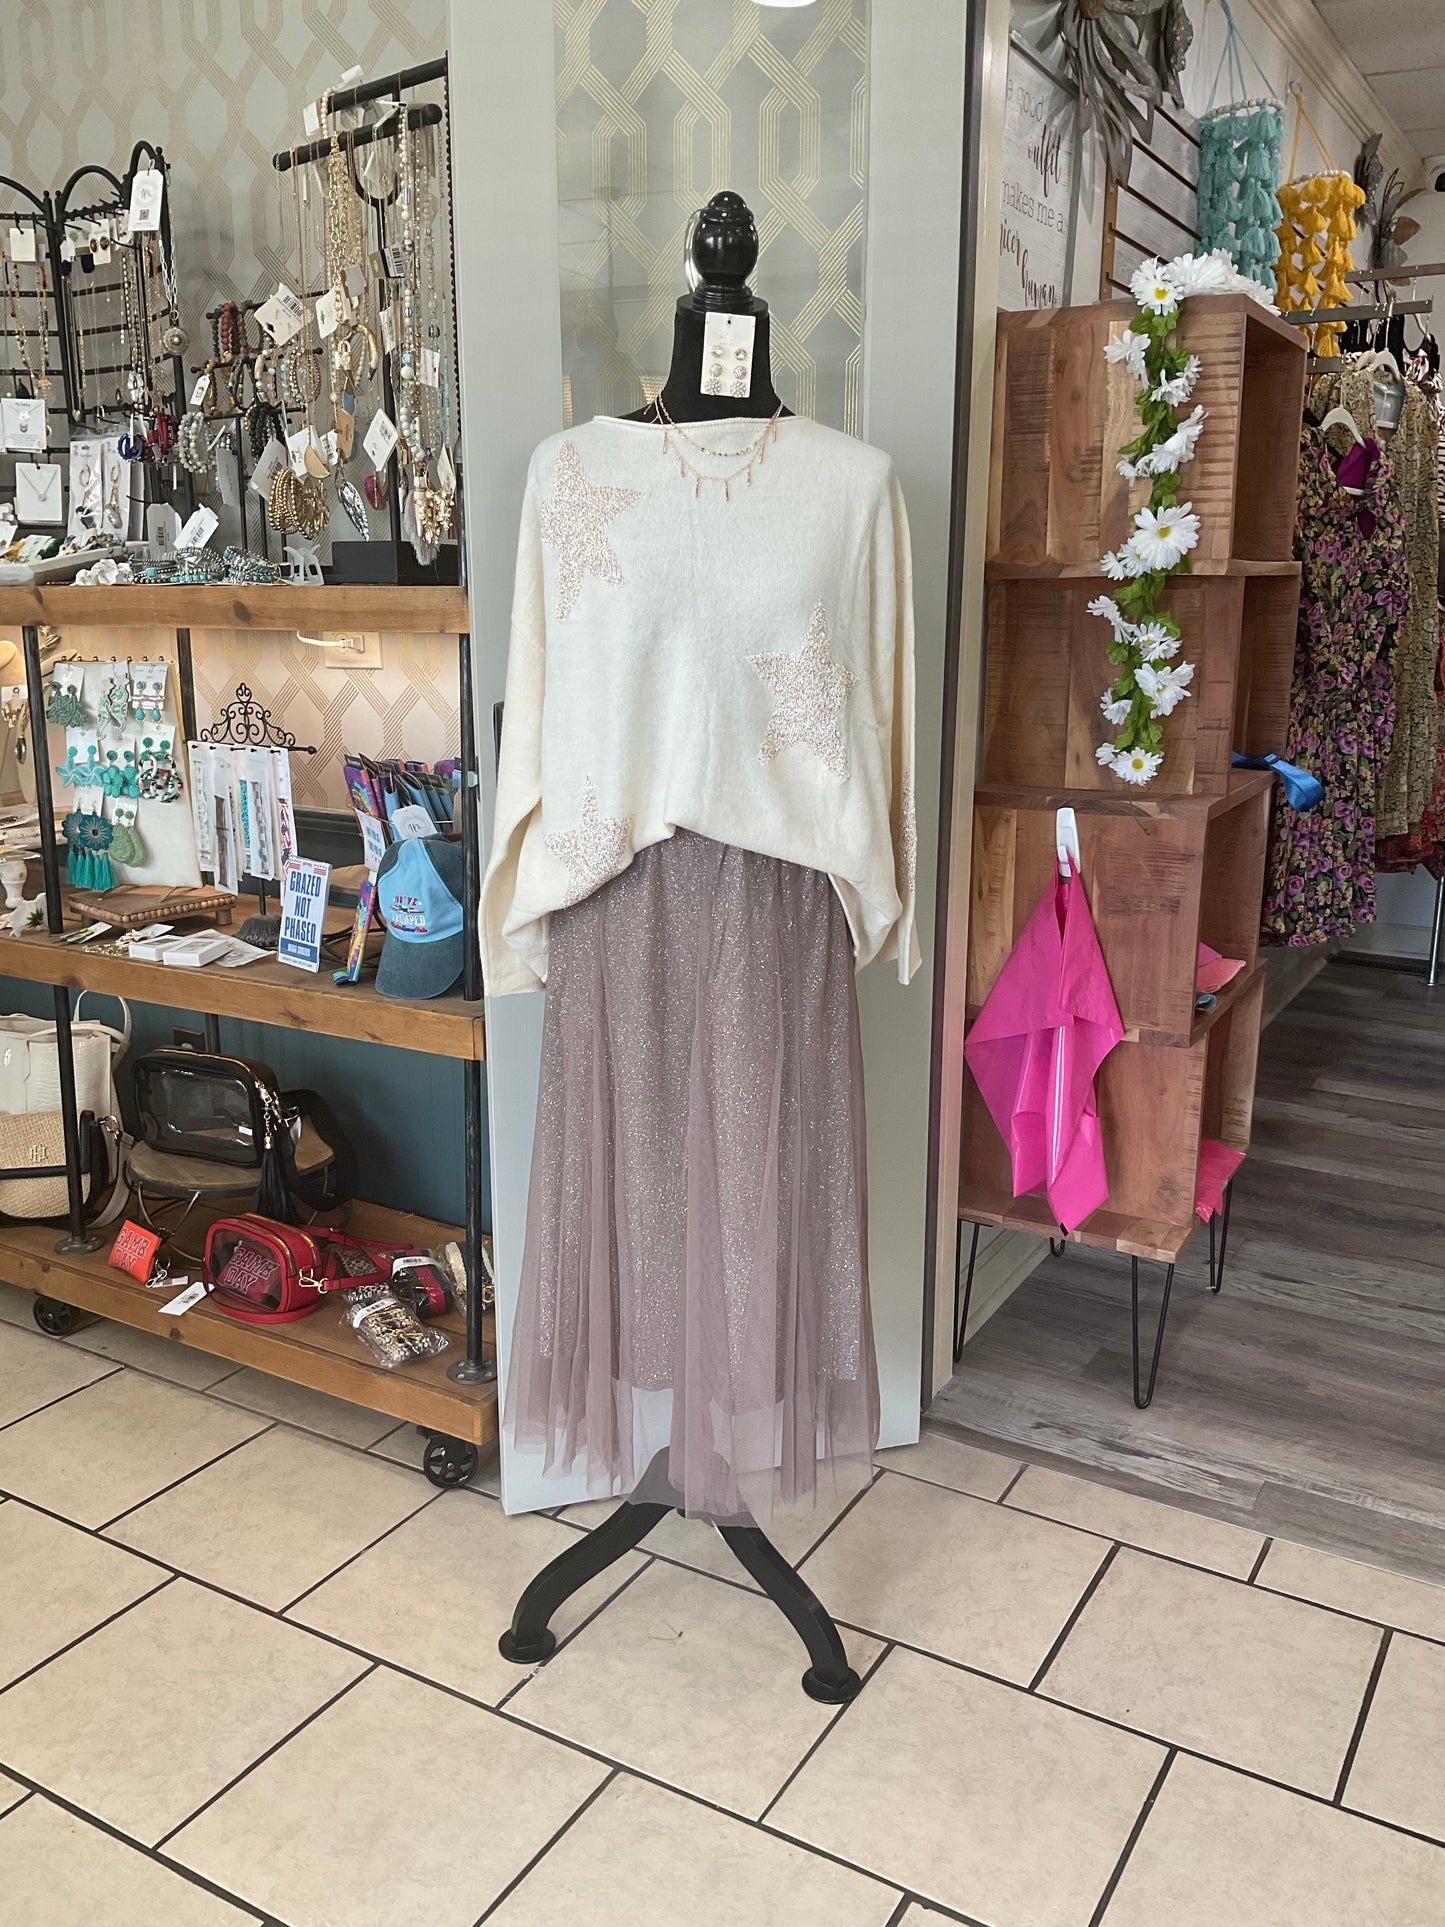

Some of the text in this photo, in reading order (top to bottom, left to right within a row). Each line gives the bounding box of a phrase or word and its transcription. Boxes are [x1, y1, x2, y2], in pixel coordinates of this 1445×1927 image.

[1007, 79, 1044, 122] a good
[1037, 201, 1055, 228] me
[1056, 213, 1065, 234] a
[289, 870, 322, 898] GRAZED
[294, 895, 312, 919] NOT
[284, 916, 317, 944] PHASED
[229, 1247, 280, 1280] GAME
[223, 1265, 259, 1295] DAY
